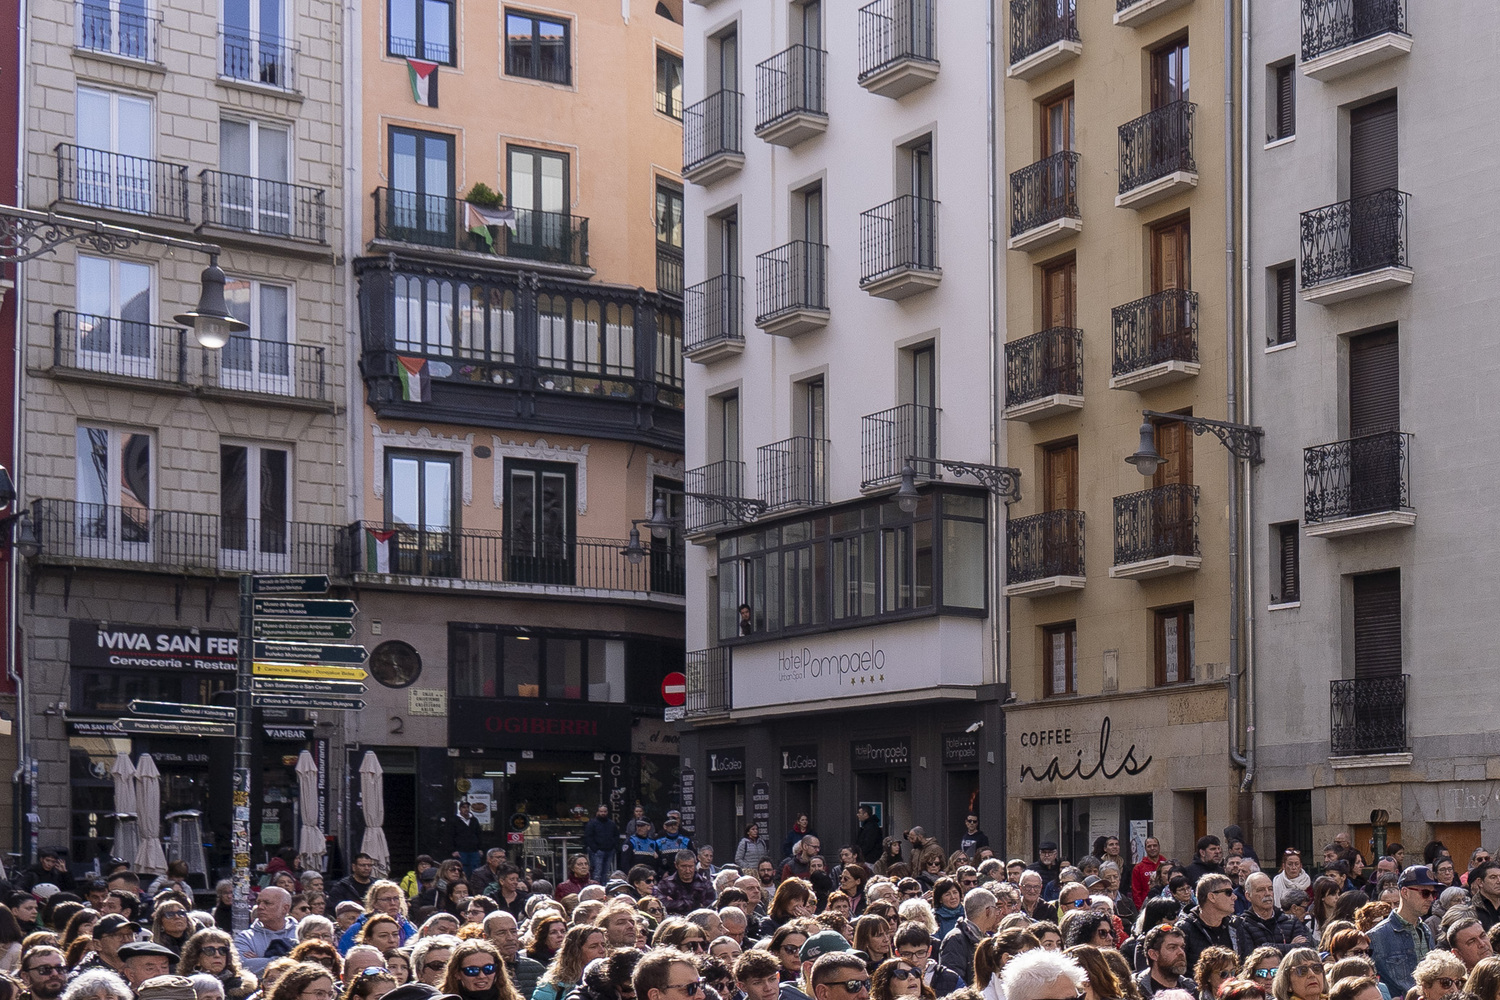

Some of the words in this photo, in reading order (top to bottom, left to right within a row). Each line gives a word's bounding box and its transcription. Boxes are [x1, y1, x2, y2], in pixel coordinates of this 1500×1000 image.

[156, 634, 200, 654] SAN
[778, 648, 803, 672] Hotel
[803, 639, 885, 686] Pompaelo
[273, 730, 306, 738] AMBAR
[389, 716, 404, 734] 2
[485, 716, 598, 736] OGIBERRI
[1020, 728, 1072, 746] COFFEE
[867, 742, 908, 763] Pompaelo
[1020, 716, 1152, 783] nails
[1449, 787, 1486, 809] The
